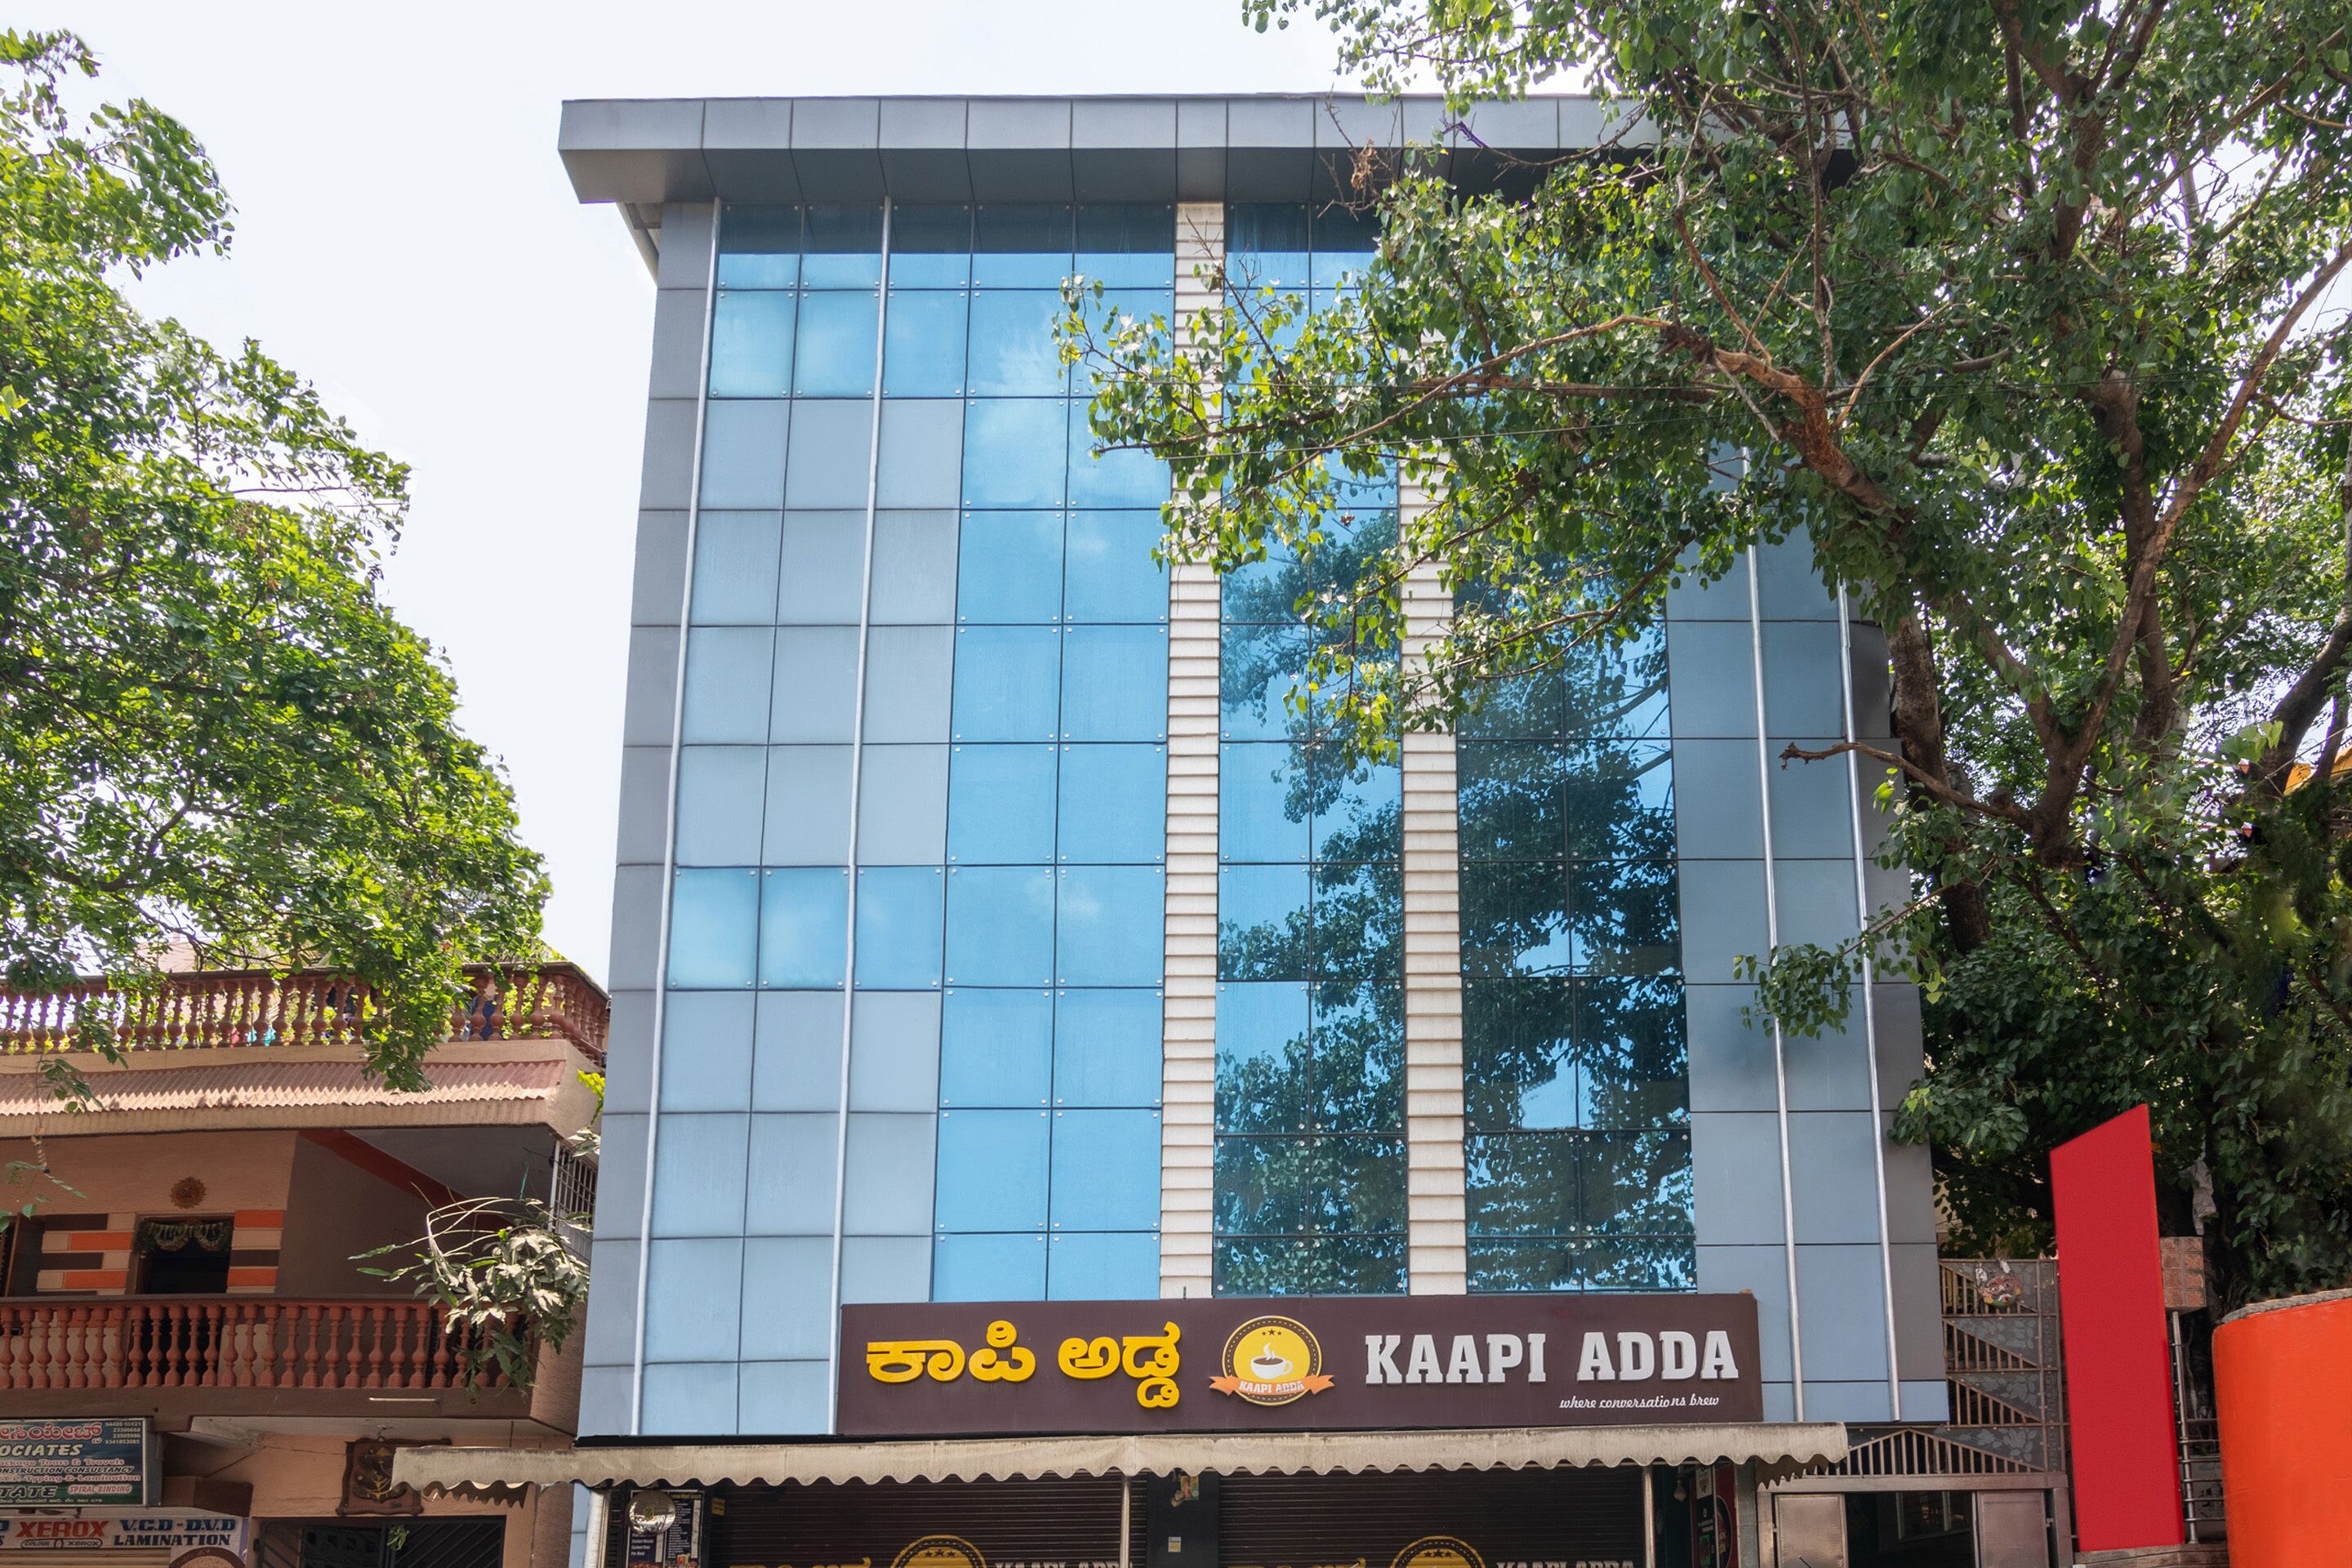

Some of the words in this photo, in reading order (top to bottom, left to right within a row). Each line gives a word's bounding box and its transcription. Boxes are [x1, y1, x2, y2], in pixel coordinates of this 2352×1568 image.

[1365, 1334, 1546, 1383] KAAPI
[1577, 1330, 1739, 1382] ADDA
[866, 1320, 1036, 1383] ಕಾಪಿ
[1058, 1321, 1180, 1408] ಅಡ್ಡ
[1239, 1380, 1272, 1393] KAAPI
[1276, 1380, 1304, 1393] ADDA
[1559, 1396, 1596, 1408] where
[1599, 1395, 1686, 1408] conversations
[1689, 1393, 1719, 1406] brew
[26, 1475, 62, 1483] Typing
[98, 1485, 131, 1493] BINDING
[16, 1521, 109, 1537] XEROX
[114, 1535, 230, 1546] LAMINATION
